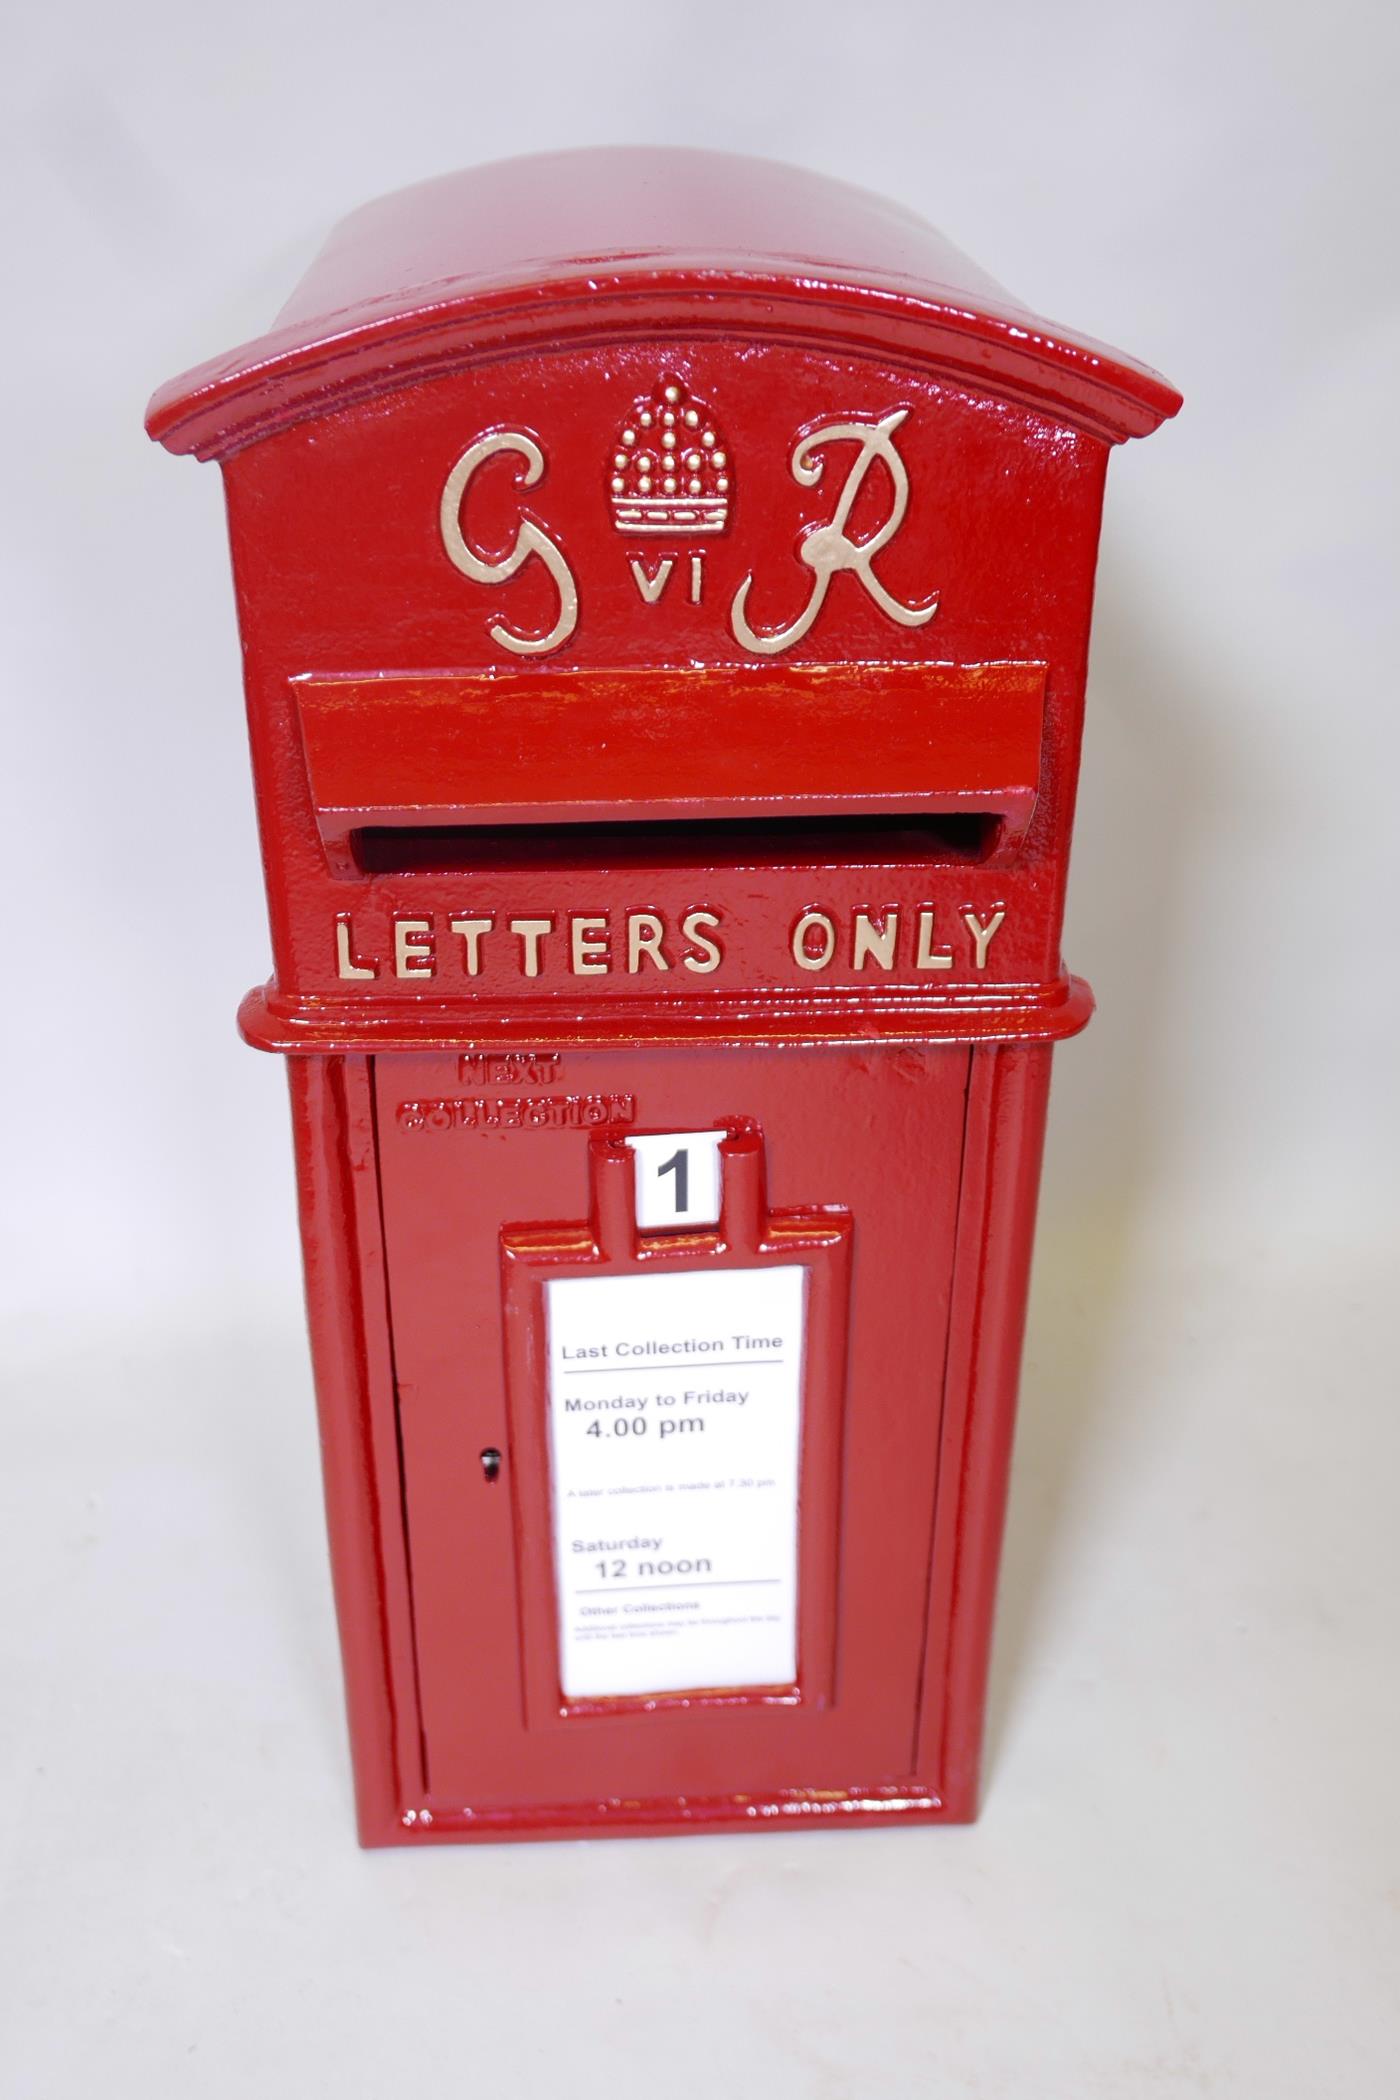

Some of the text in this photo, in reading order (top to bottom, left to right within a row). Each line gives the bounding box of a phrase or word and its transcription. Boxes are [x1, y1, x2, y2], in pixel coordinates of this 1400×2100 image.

[440, 409, 939, 655] G R
[630, 555, 702, 604] VI
[336, 906, 1006, 981] LETTERS ONLY
[459, 1054, 560, 1085] NEXT
[397, 1095, 636, 1132] COLLECTION
[656, 1148, 690, 1214] 1
[561, 1335, 784, 1360] Last Collection Time
[564, 1389, 750, 1412] Monday to Friday
[586, 1416, 706, 1439] 4.00 pm
[571, 1535, 663, 1553] Saturday
[595, 1557, 713, 1579] 12 noon
